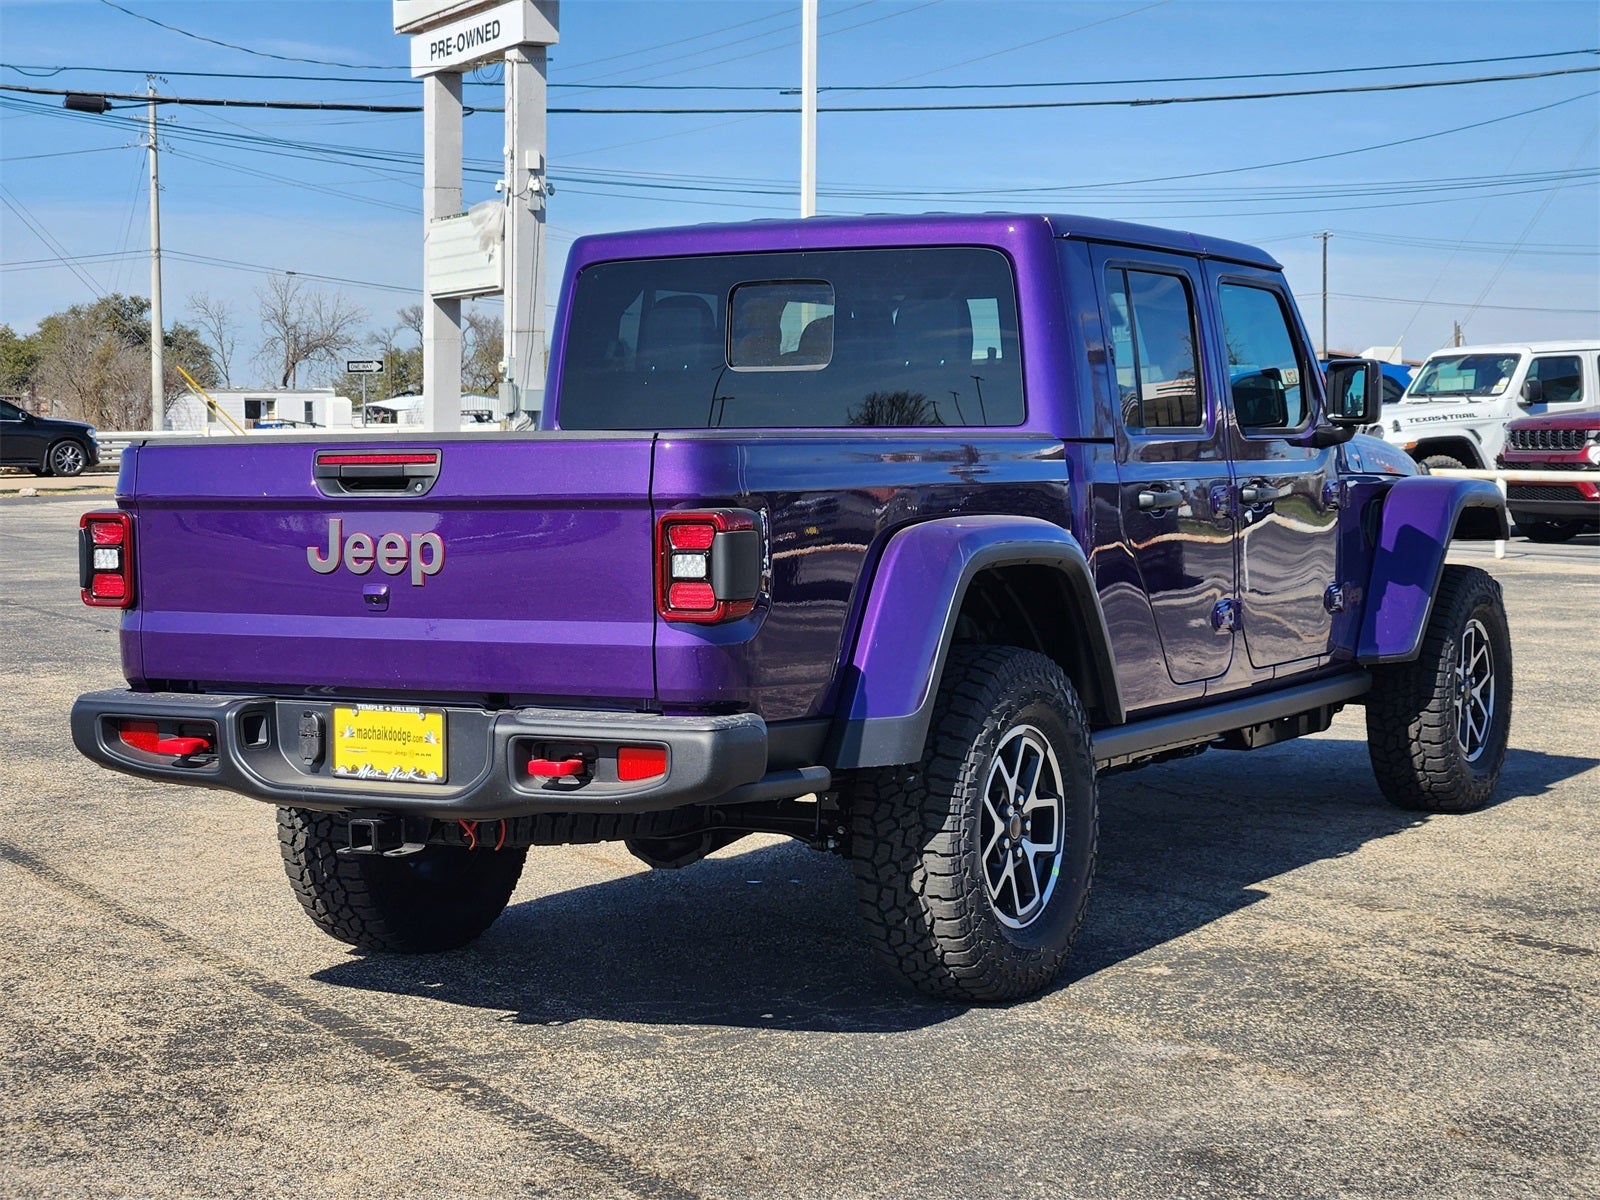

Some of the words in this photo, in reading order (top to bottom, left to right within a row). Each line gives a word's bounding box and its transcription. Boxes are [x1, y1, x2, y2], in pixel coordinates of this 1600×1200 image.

[430, 19, 501, 61] PRE-OWNED
[1407, 415, 1441, 423] TEXAS
[1447, 412, 1478, 420] TRAIL
[306, 518, 447, 587] Jeep
[356, 703, 384, 711] TEMPLE
[356, 725, 423, 746] machaikdodge.com
[356, 763, 384, 779] Mac
[386, 765, 418, 780] Haik
